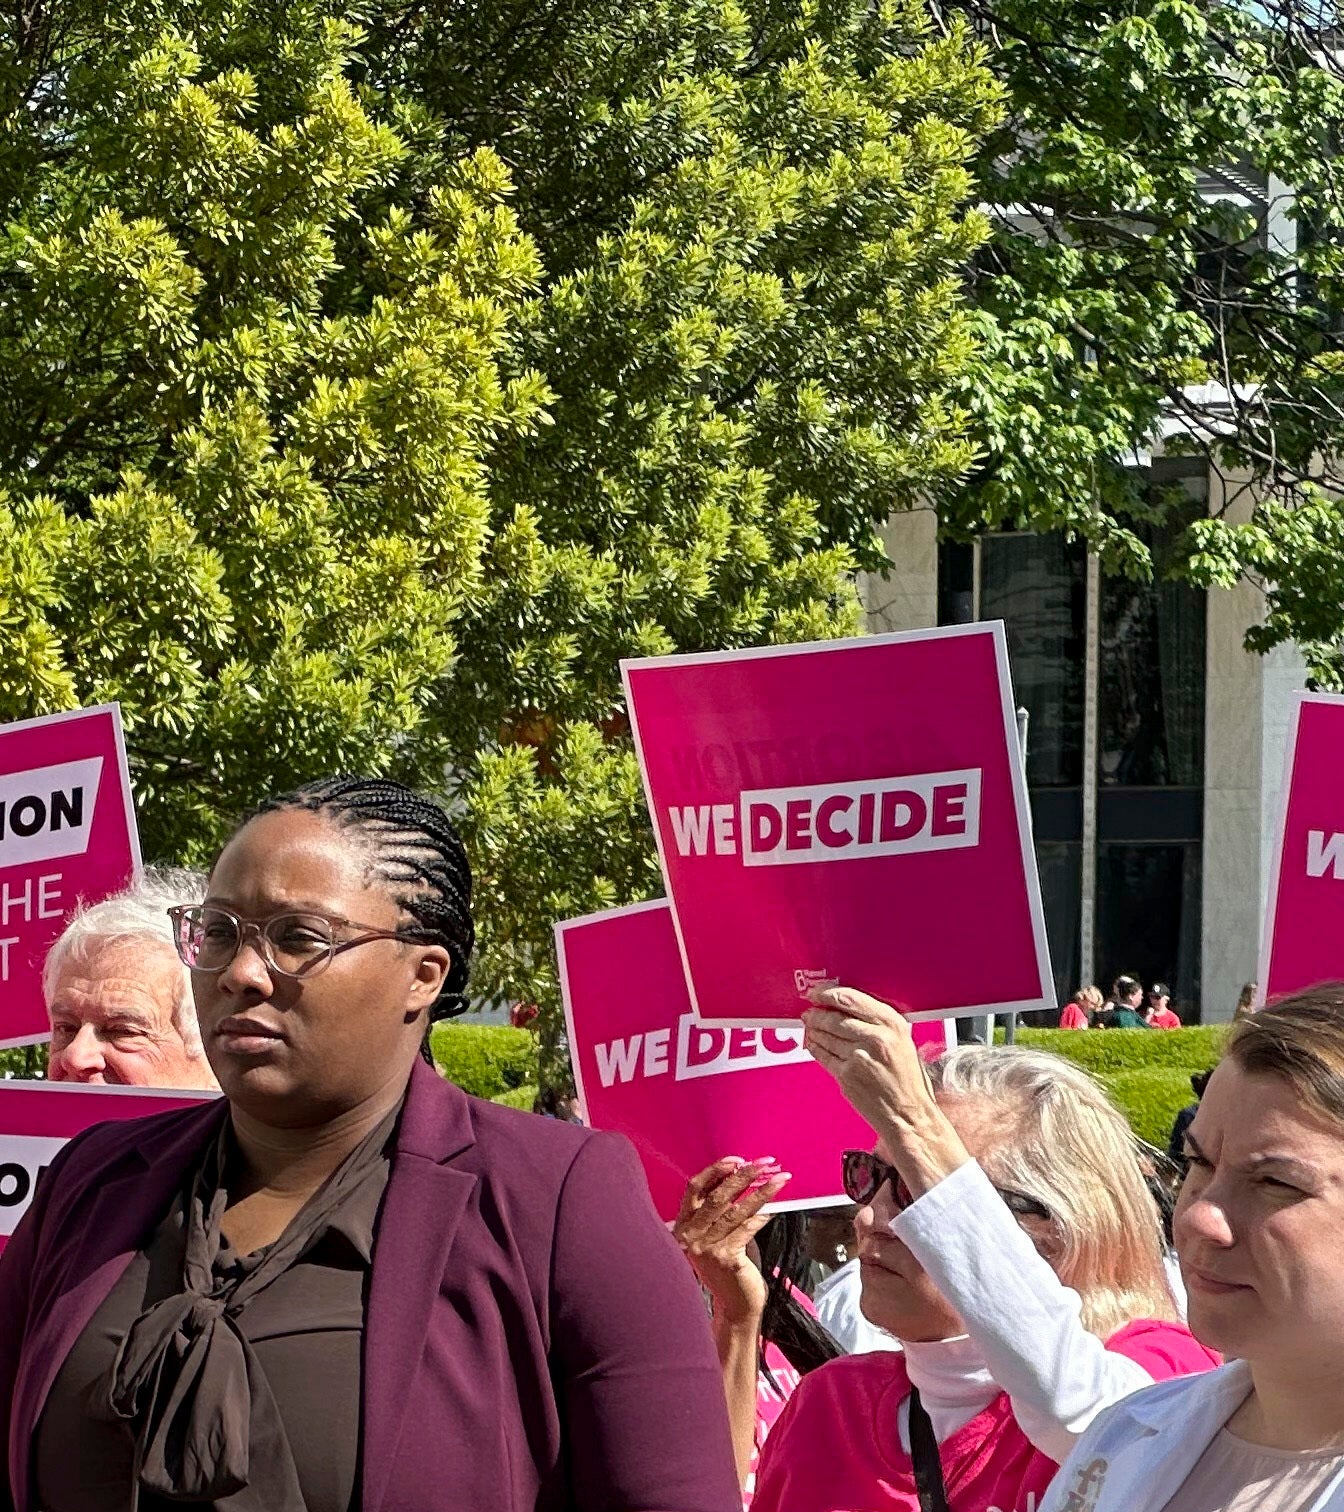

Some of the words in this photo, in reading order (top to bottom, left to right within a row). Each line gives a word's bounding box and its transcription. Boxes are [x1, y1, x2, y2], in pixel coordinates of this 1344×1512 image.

[668, 804, 736, 856] WE
[750, 783, 968, 853] DECIDE
[595, 1028, 670, 1088] WE
[686, 1027, 799, 1067] DEC
